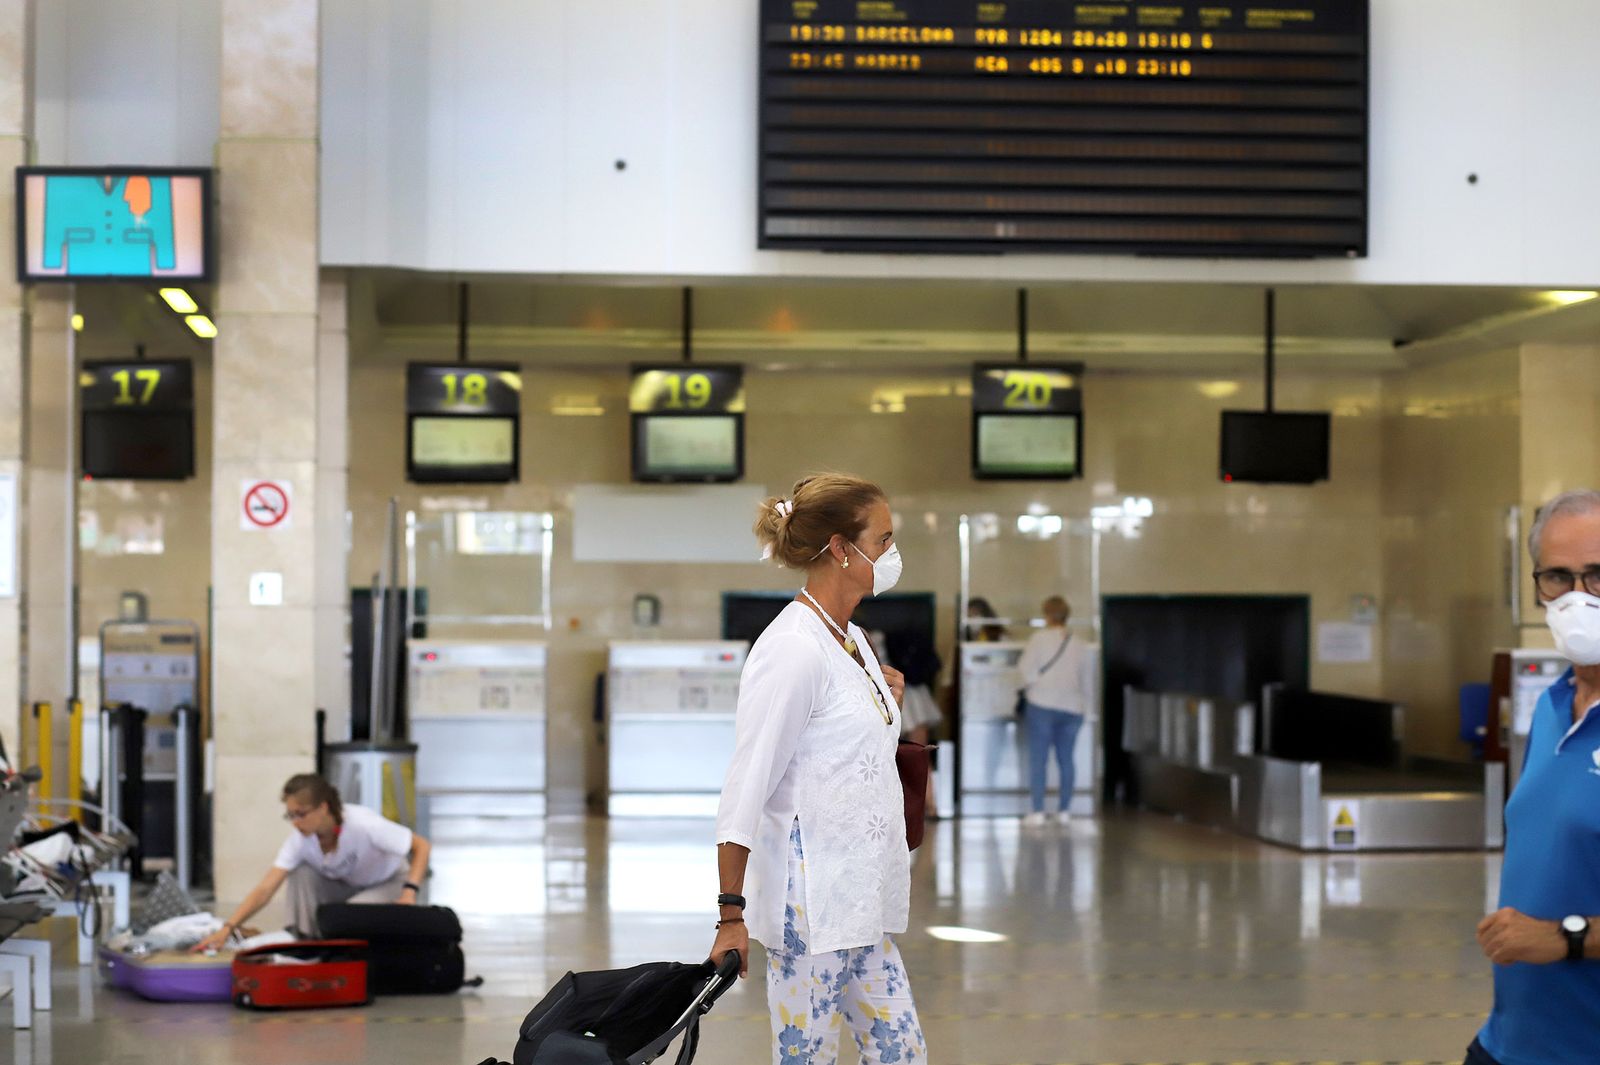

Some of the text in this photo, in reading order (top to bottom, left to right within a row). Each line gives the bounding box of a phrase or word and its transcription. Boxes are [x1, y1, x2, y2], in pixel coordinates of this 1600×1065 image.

[855, 25, 955, 43] BARCELONA
[1201, 33, 1214, 50] 6
[112, 369, 161, 406] 17
[442, 372, 487, 407] 18
[664, 374, 712, 408] 19
[1003, 371, 1052, 409] 20
